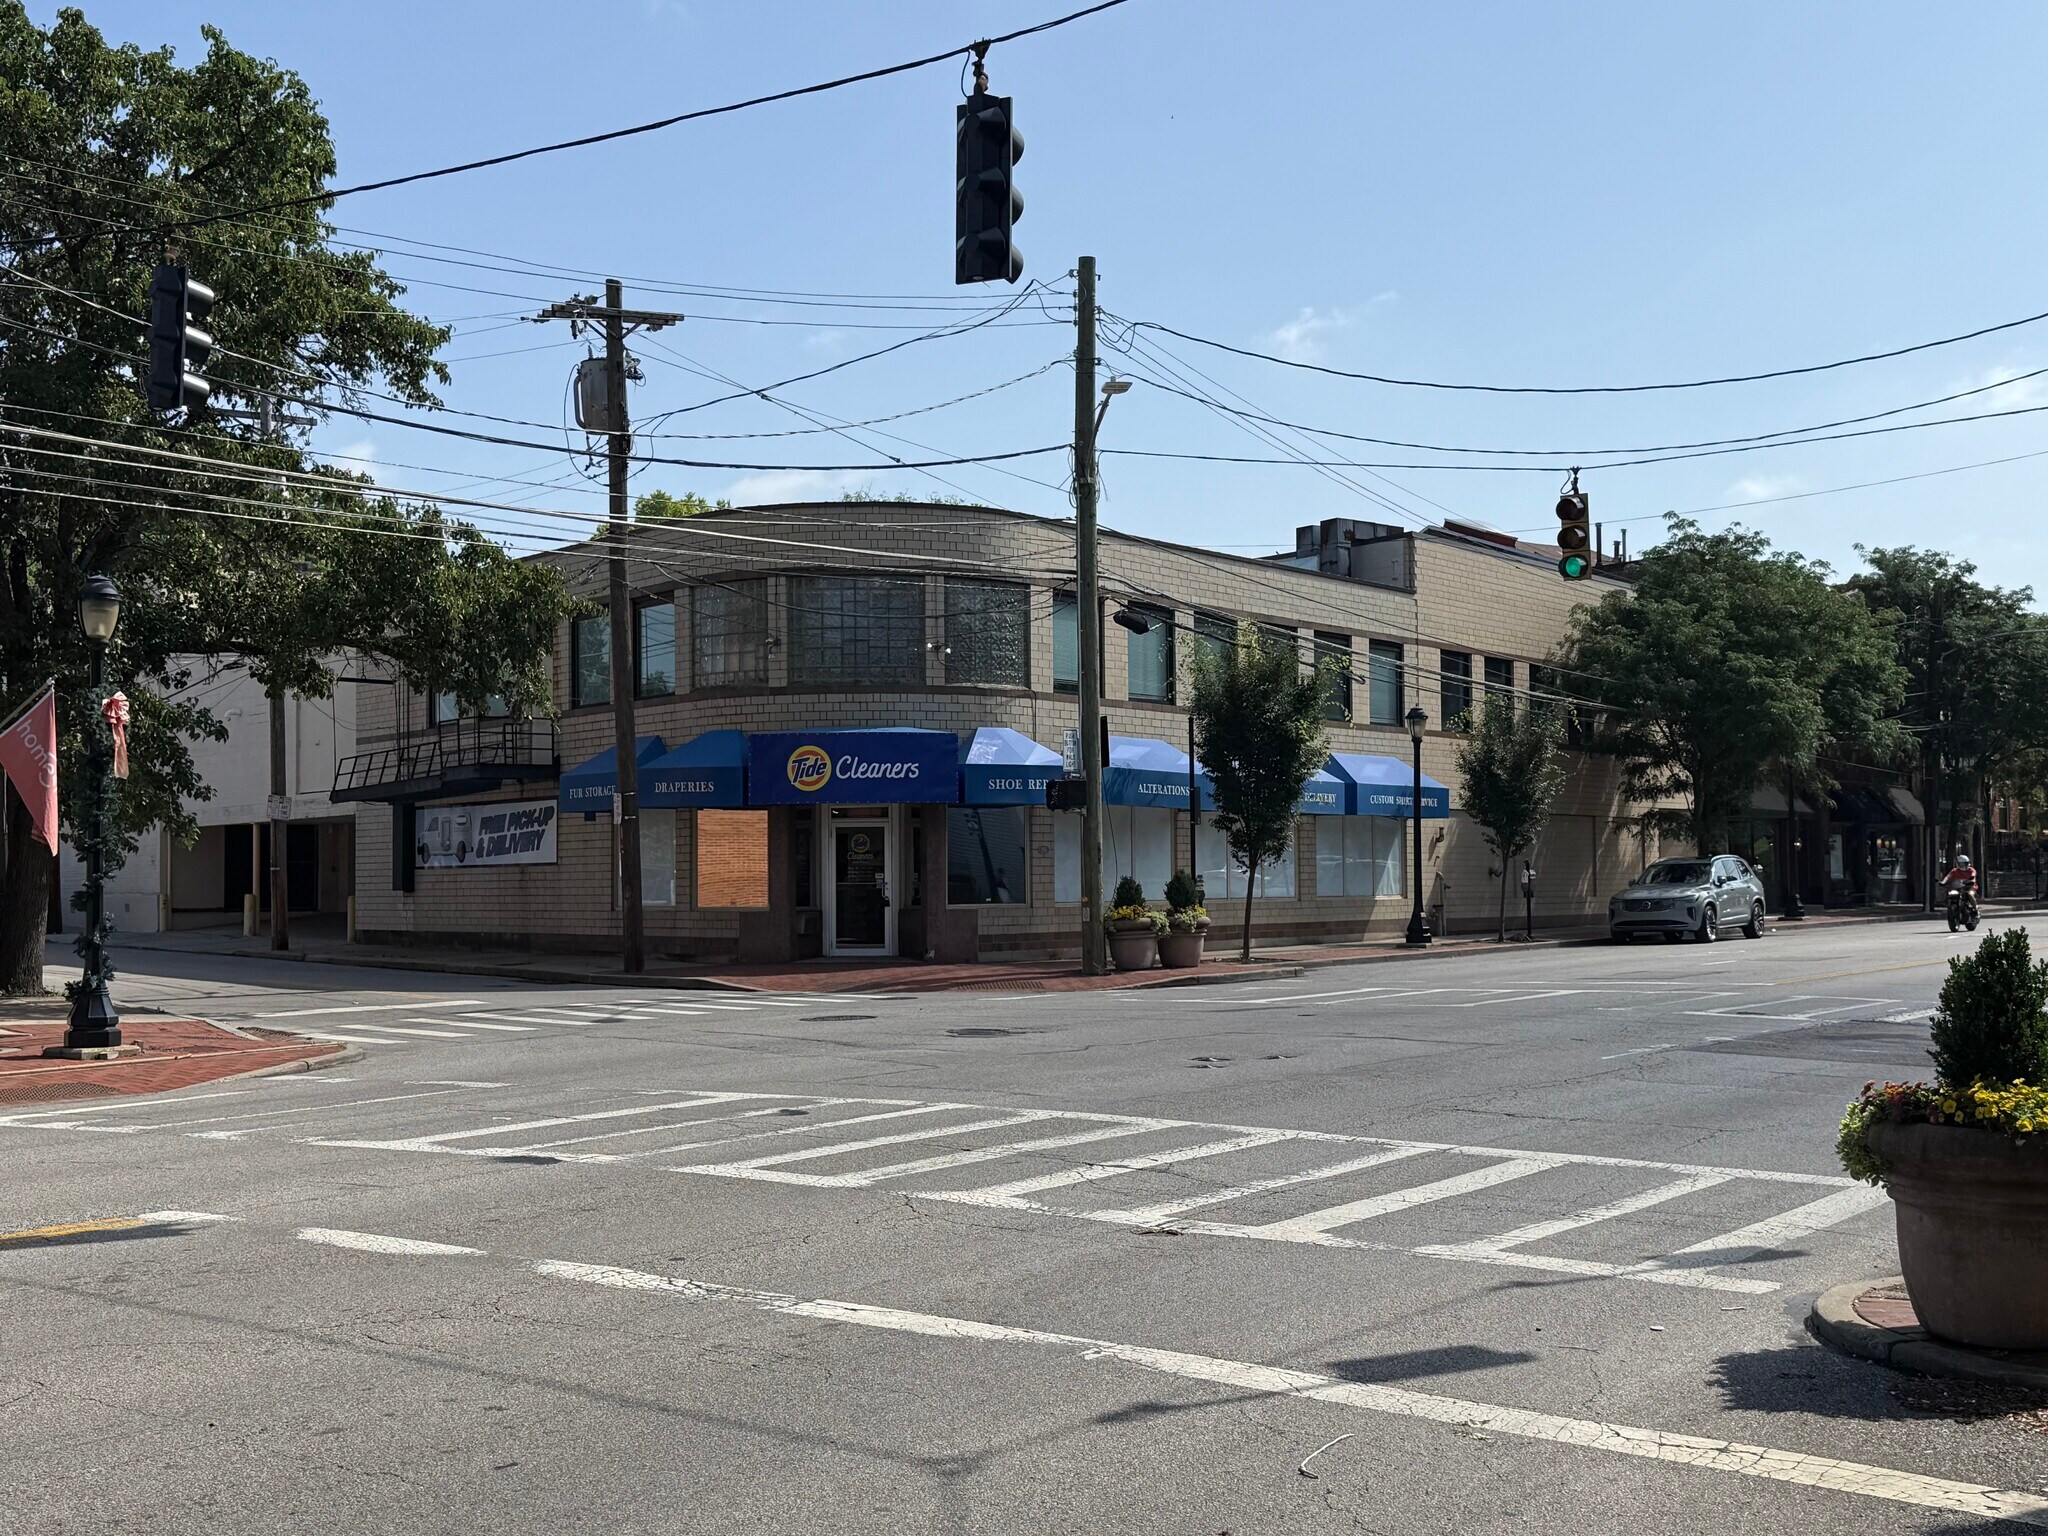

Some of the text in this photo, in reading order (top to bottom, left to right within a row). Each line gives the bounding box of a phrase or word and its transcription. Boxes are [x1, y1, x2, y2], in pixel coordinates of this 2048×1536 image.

[791, 754, 919, 785] Tide Cleaners
[655, 781, 715, 793] DRAPERIES
[988, 778, 1023, 790] SHOE
[1138, 782, 1190, 797] ALTERATIONS
[569, 788, 583, 799] FUR
[1369, 794, 1394, 805] CUSTOM
[479, 805, 554, 836] FREE PICK-UP
[476, 829, 545, 859] & DELIVERY
